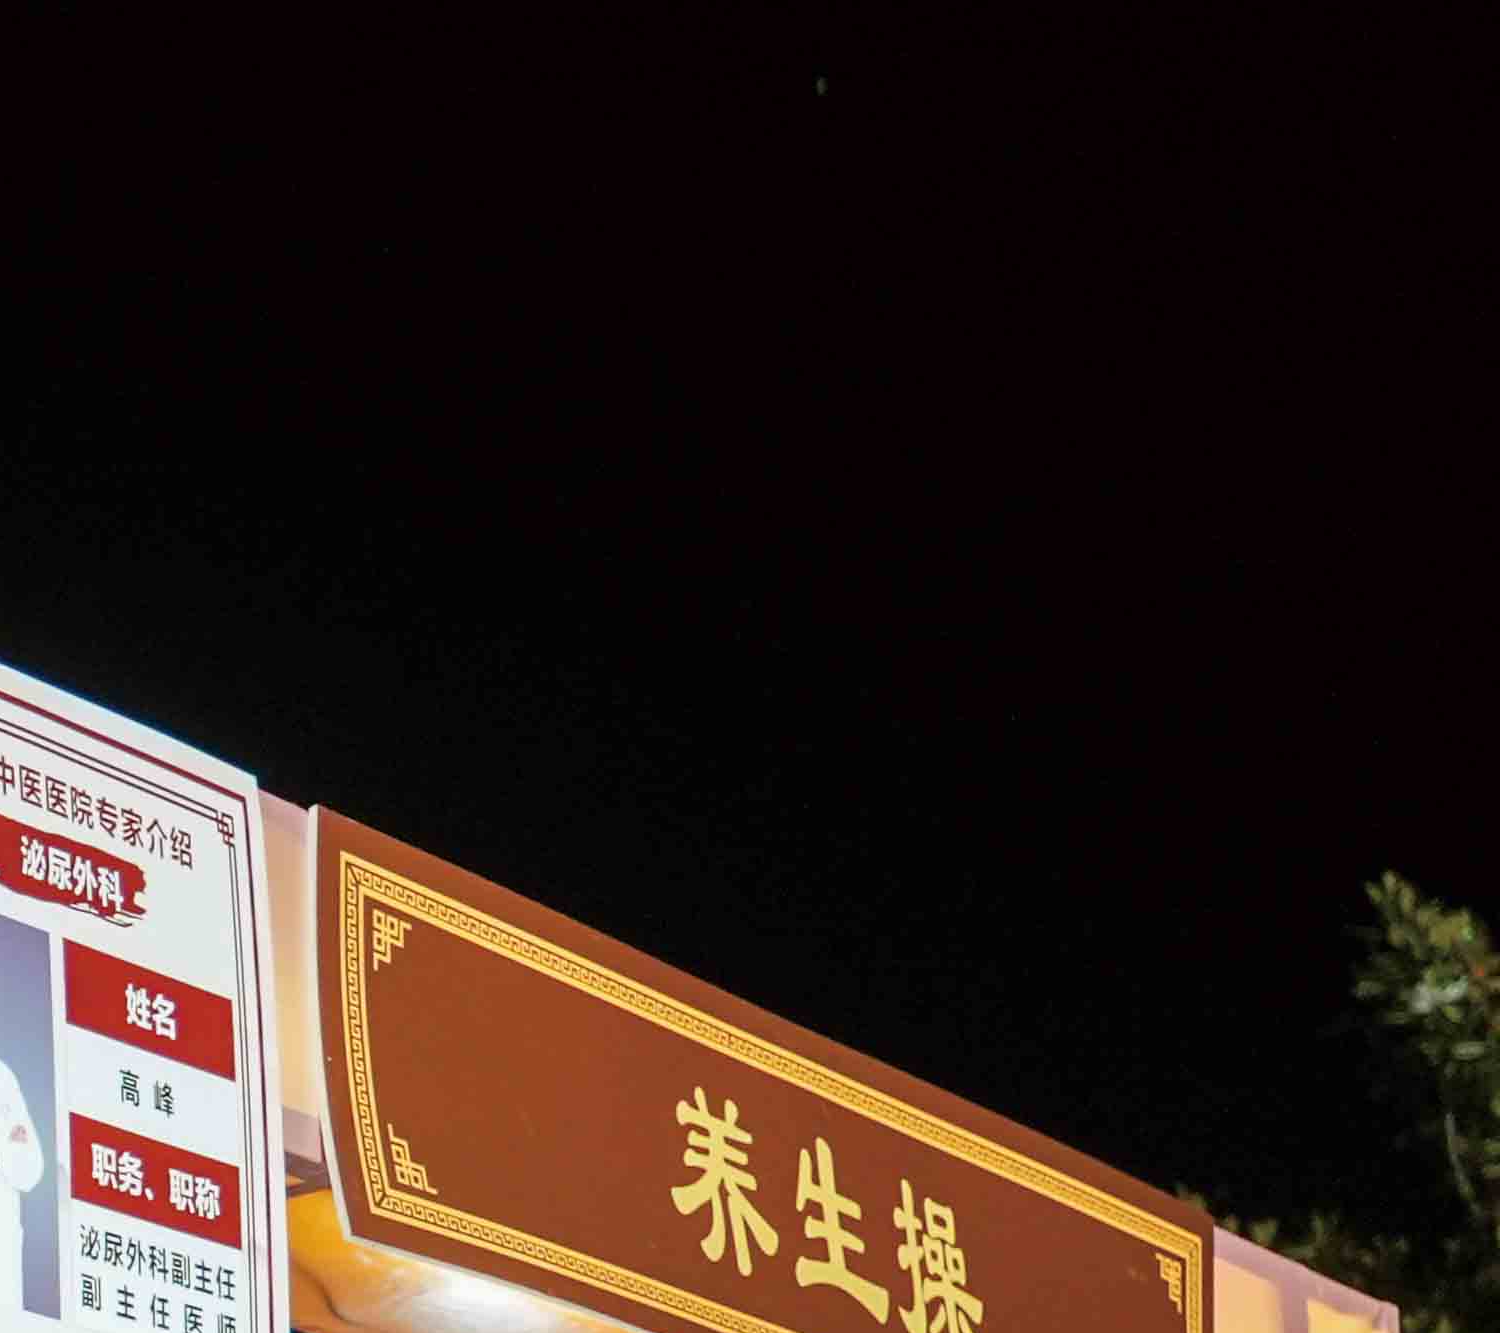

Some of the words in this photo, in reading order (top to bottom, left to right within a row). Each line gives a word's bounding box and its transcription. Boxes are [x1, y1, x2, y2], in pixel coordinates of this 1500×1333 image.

[20, 834, 126, 912] 泌尿外科
[124, 982, 178, 1041] 姓名
[91, 1142, 221, 1221] 职务、职称
[79, 1223, 236, 1301] 泌尿外科副主任
